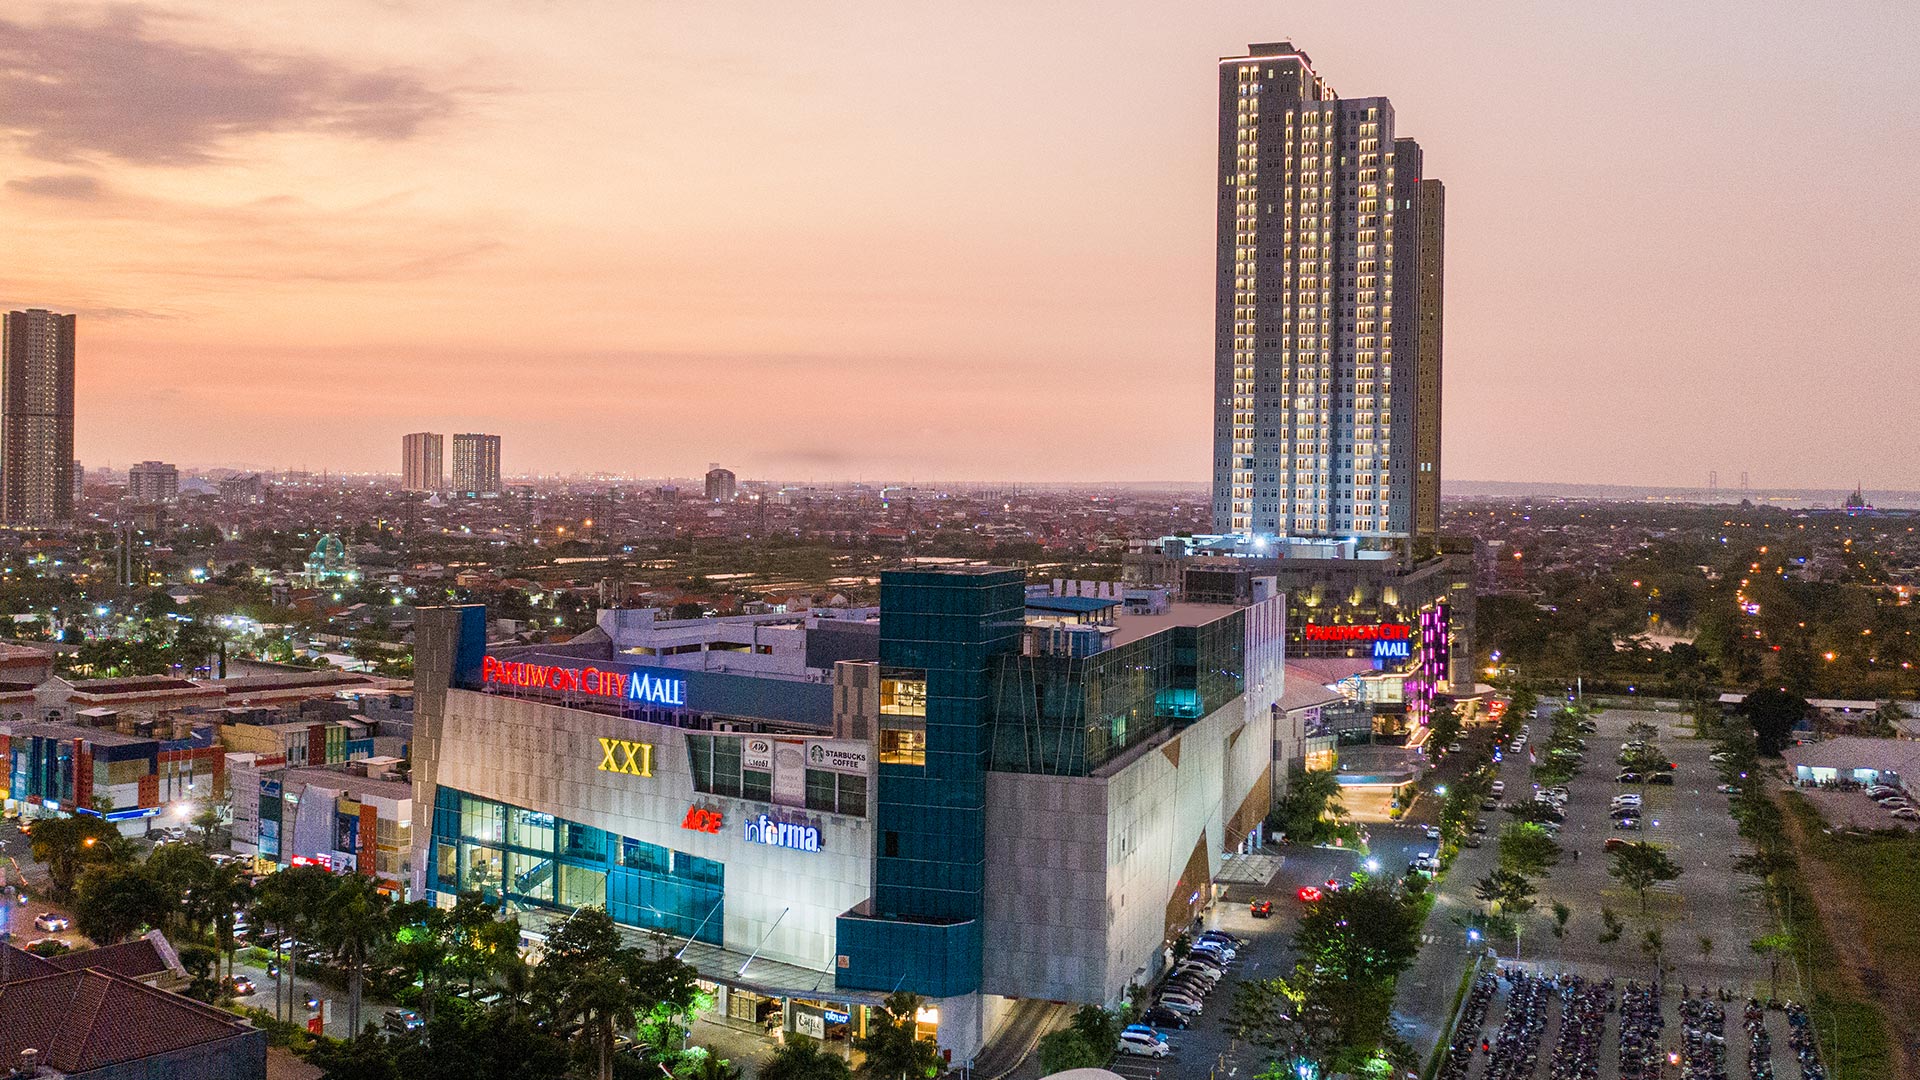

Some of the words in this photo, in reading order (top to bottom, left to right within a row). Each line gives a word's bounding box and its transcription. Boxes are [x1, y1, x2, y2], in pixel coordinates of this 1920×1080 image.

[1306, 623, 1379, 640] PAKUWON
[1380, 623, 1411, 640] CITY
[1374, 641, 1410, 657] MALL
[482, 655, 579, 692] PAKUWON
[581, 667, 628, 698] CITY
[630, 672, 684, 705] MALL
[597, 738, 653, 777] XXI
[825, 749, 866, 761] STARBUCKS
[832, 759, 859, 768] COFFEE
[680, 804, 724, 834] ACE
